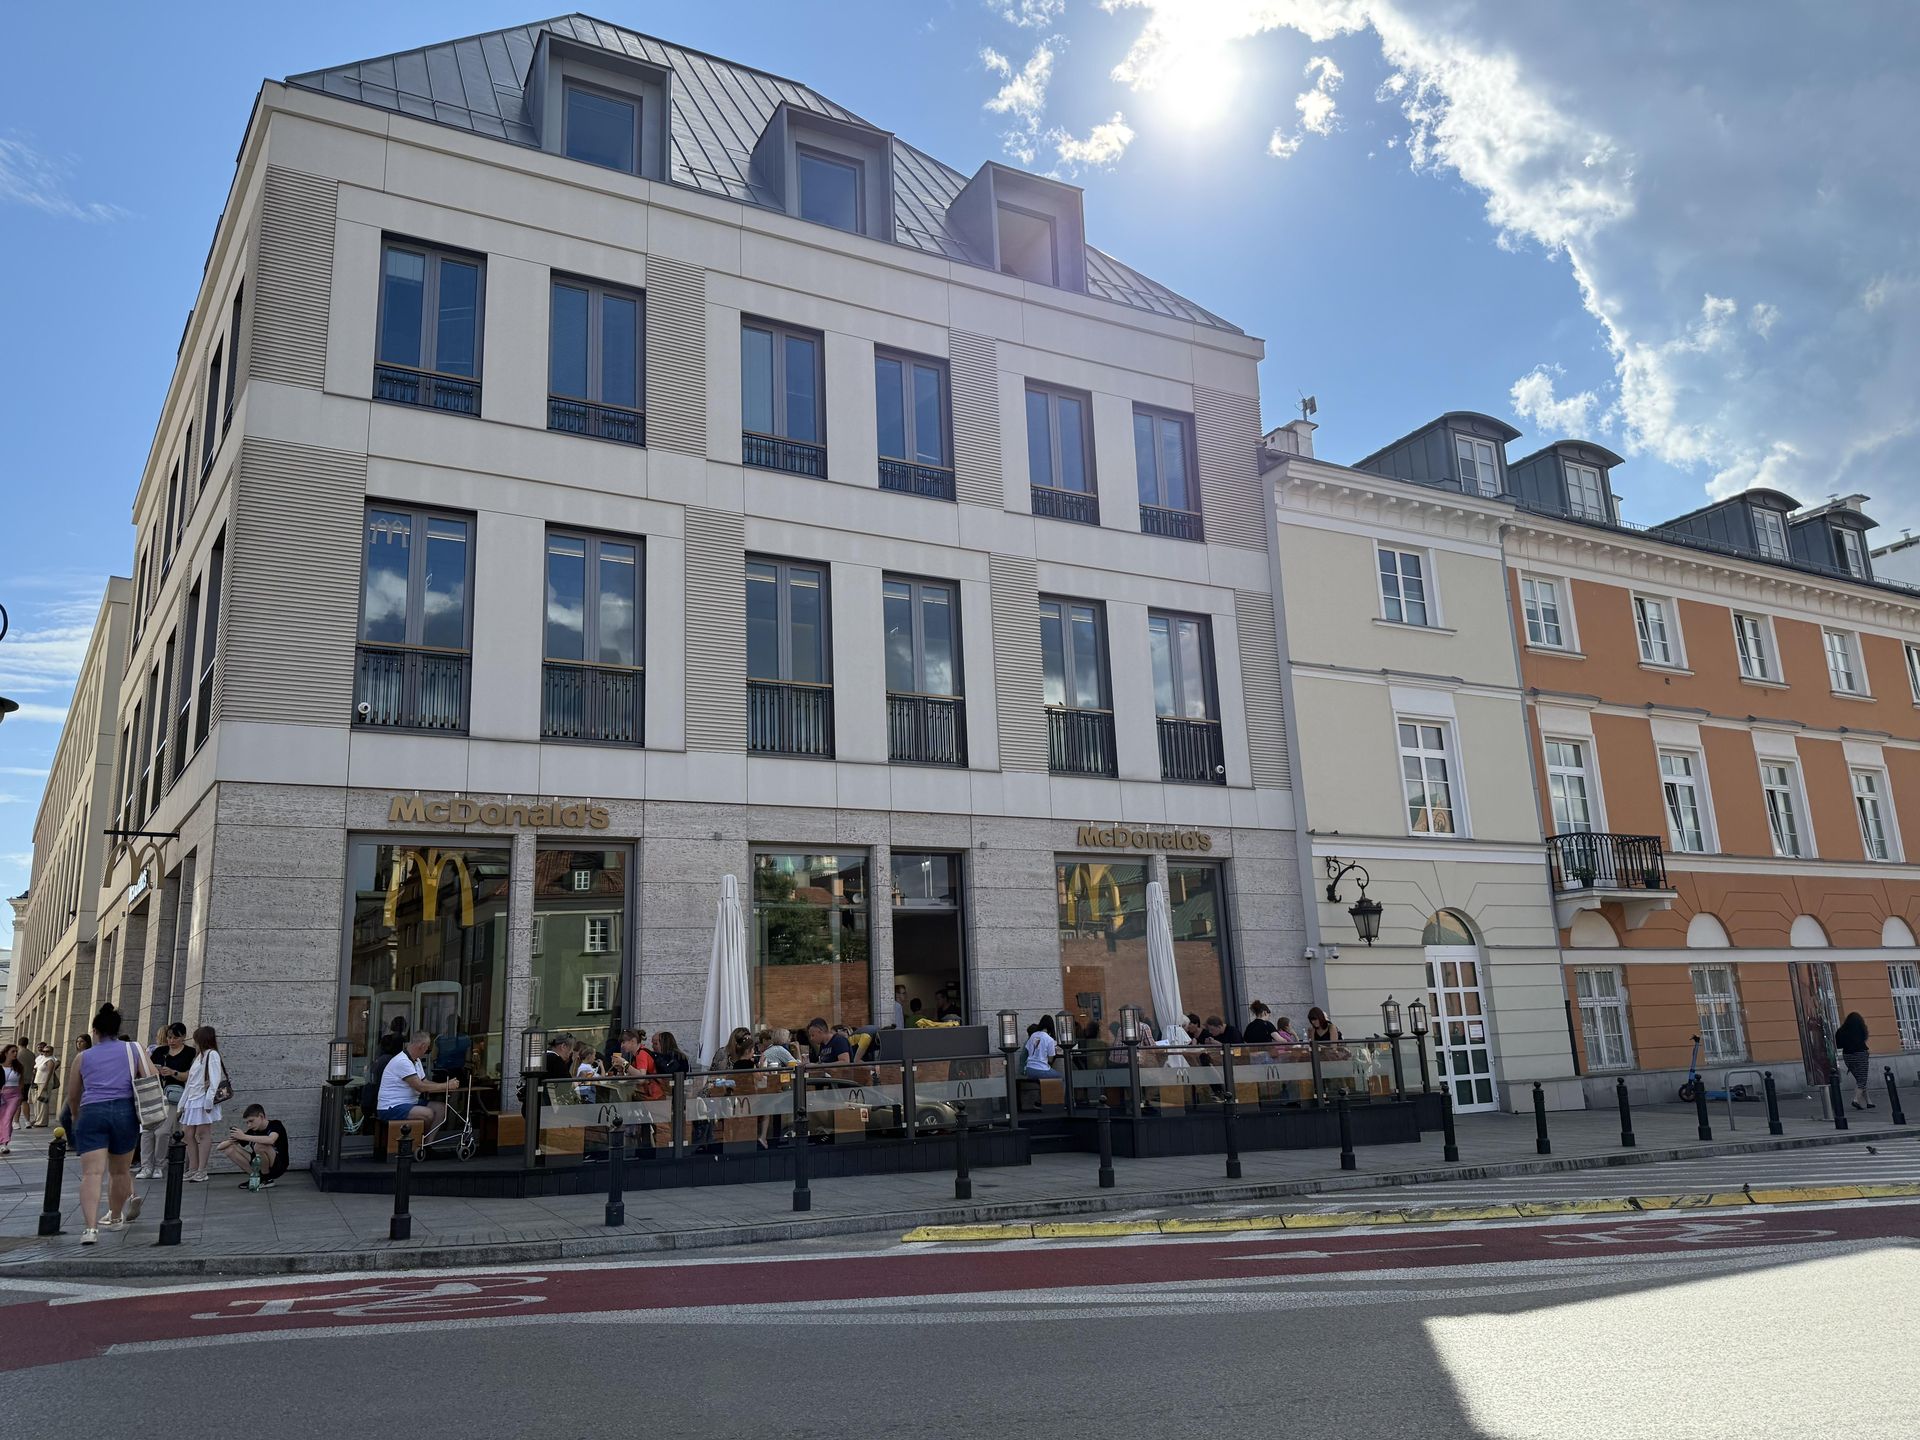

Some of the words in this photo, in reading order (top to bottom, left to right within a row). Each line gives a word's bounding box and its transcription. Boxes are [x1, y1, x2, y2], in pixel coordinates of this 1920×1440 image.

[388, 796, 611, 829] McDonald's
[1078, 826, 1213, 850] McDonald's
[103, 840, 165, 889] M
[383, 850, 473, 928] M
[850, 1089, 864, 1104] M
[957, 1081, 972, 1098] M
